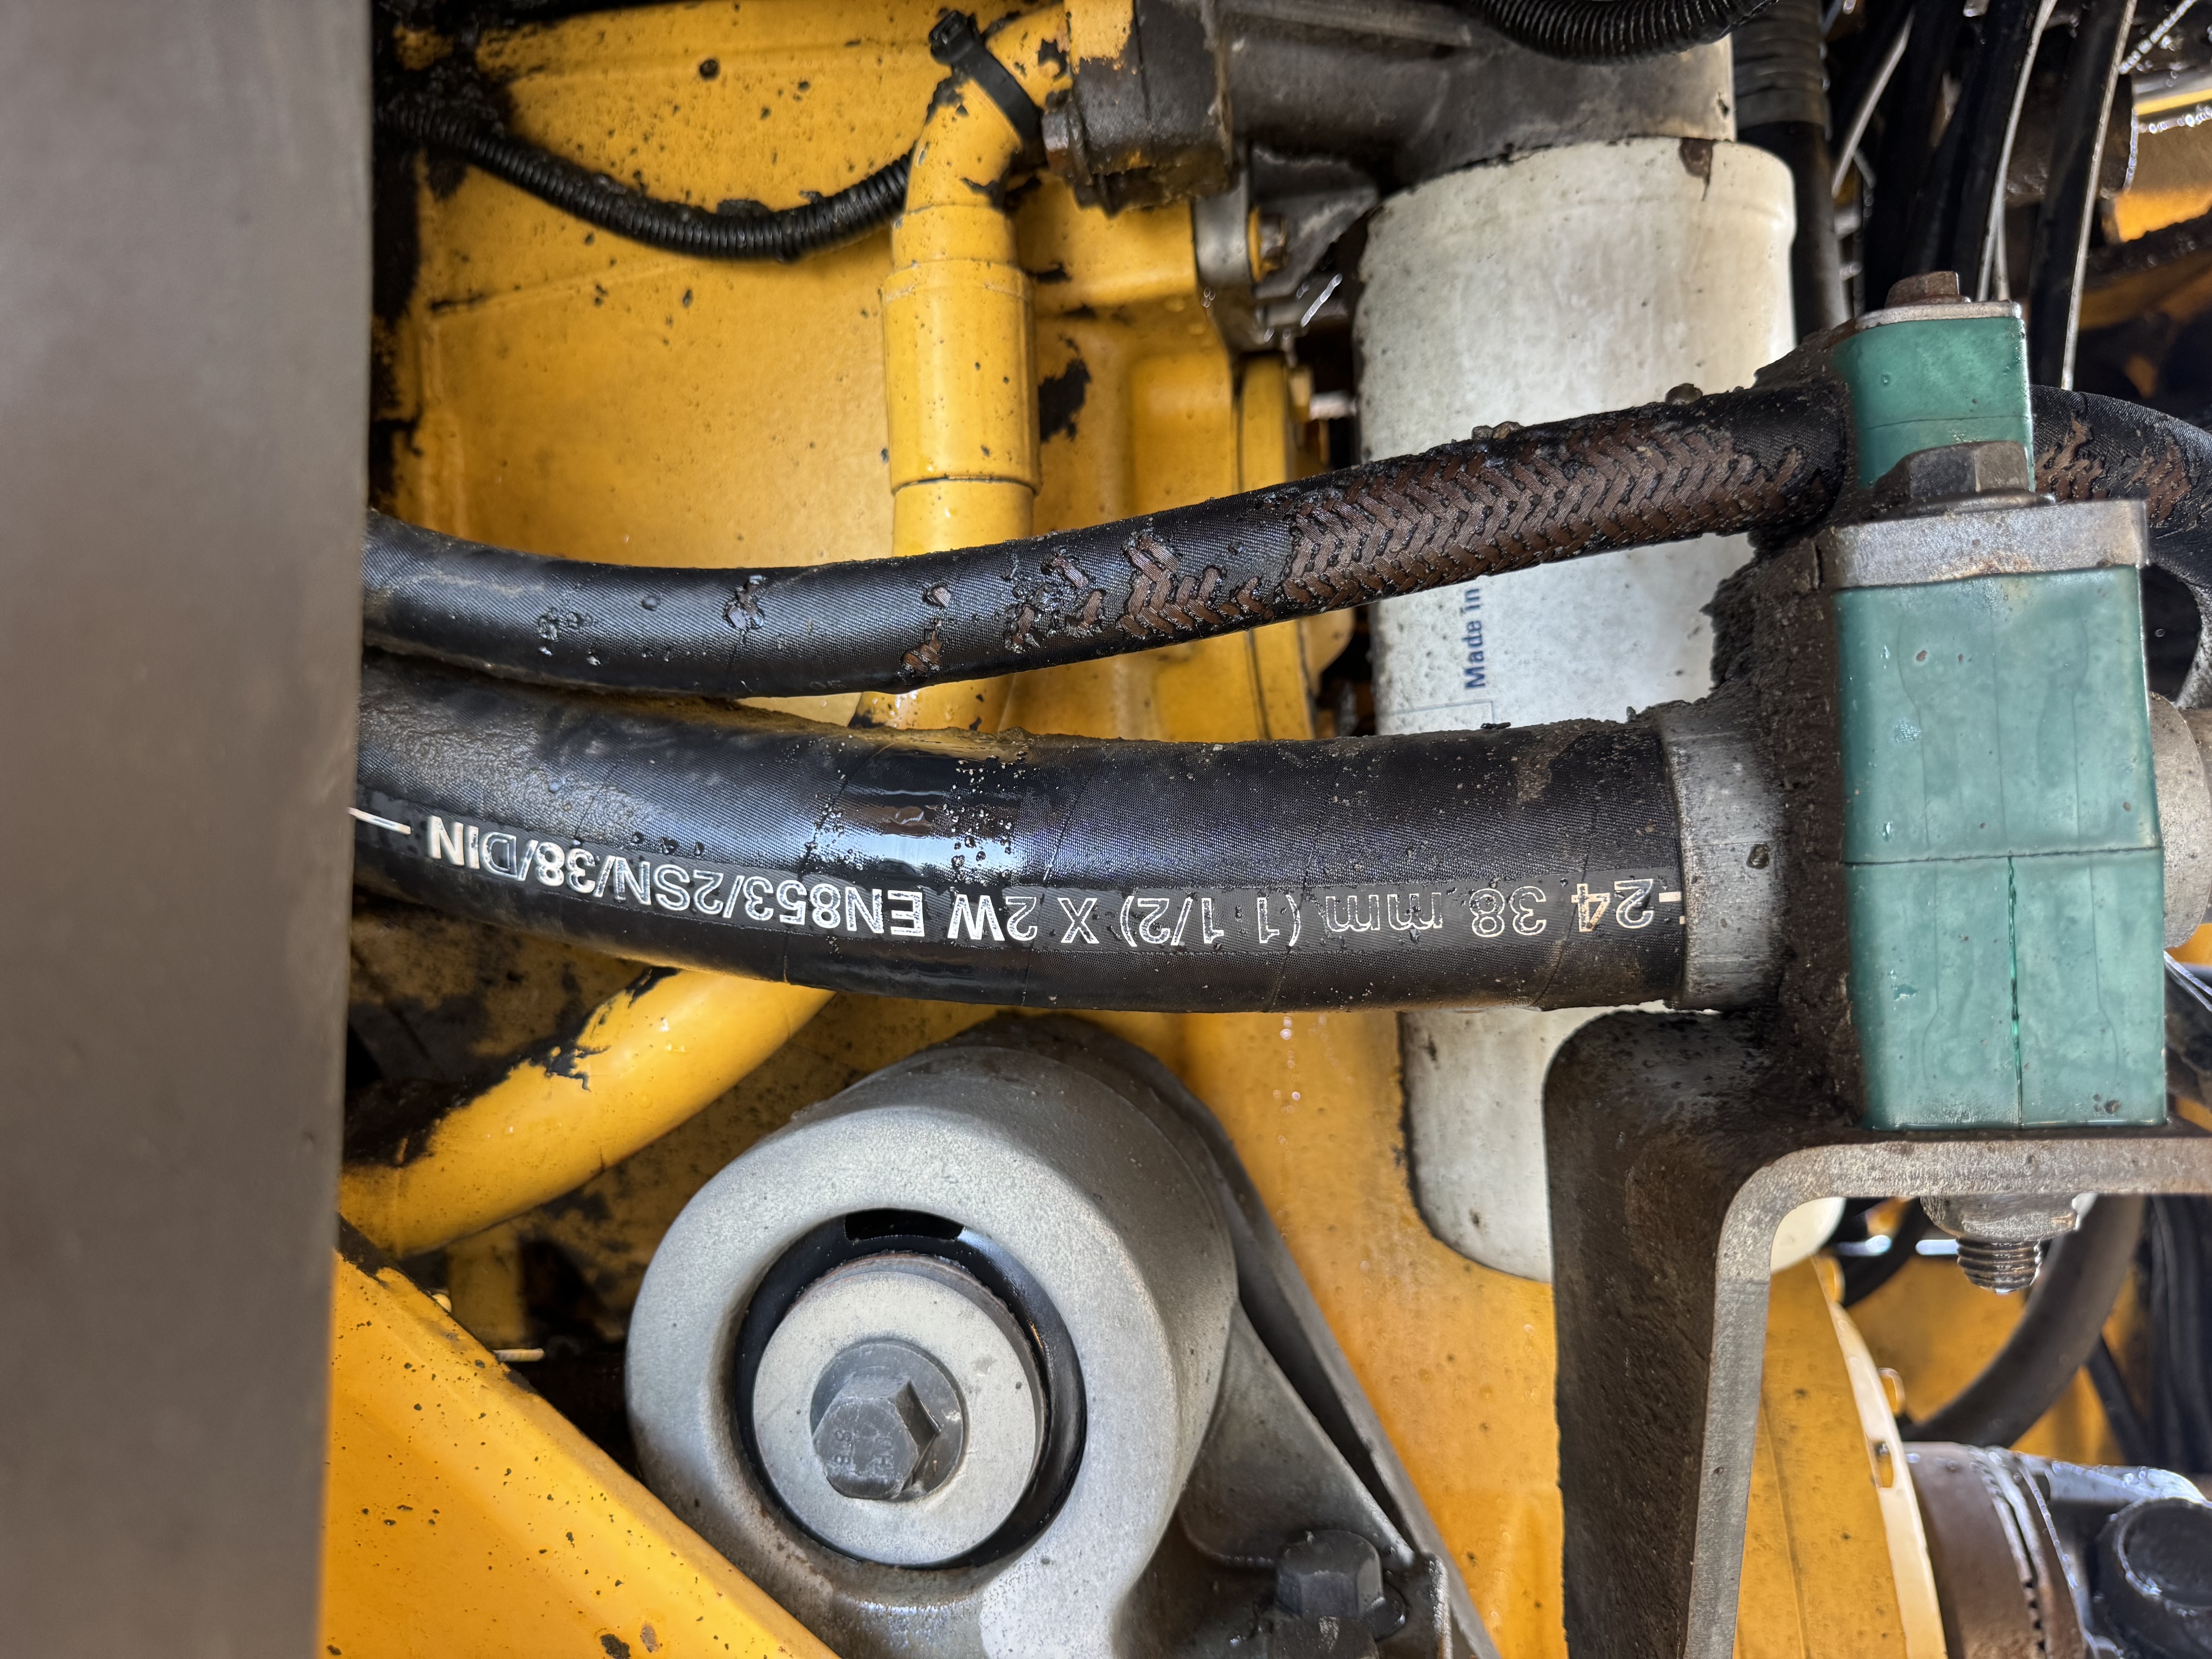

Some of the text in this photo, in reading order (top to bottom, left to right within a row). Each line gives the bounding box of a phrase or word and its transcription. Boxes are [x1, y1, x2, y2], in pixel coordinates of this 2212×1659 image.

[1461, 588, 1486, 689] Made in
[947, 894, 1038, 941] 2W
[1057, 897, 1100, 944] X
[1120, 895, 1224, 947] 1/2)
[1258, 895, 1302, 947] (1
[1326, 892, 1443, 931] mm
[1469, 886, 1546, 937] 38
